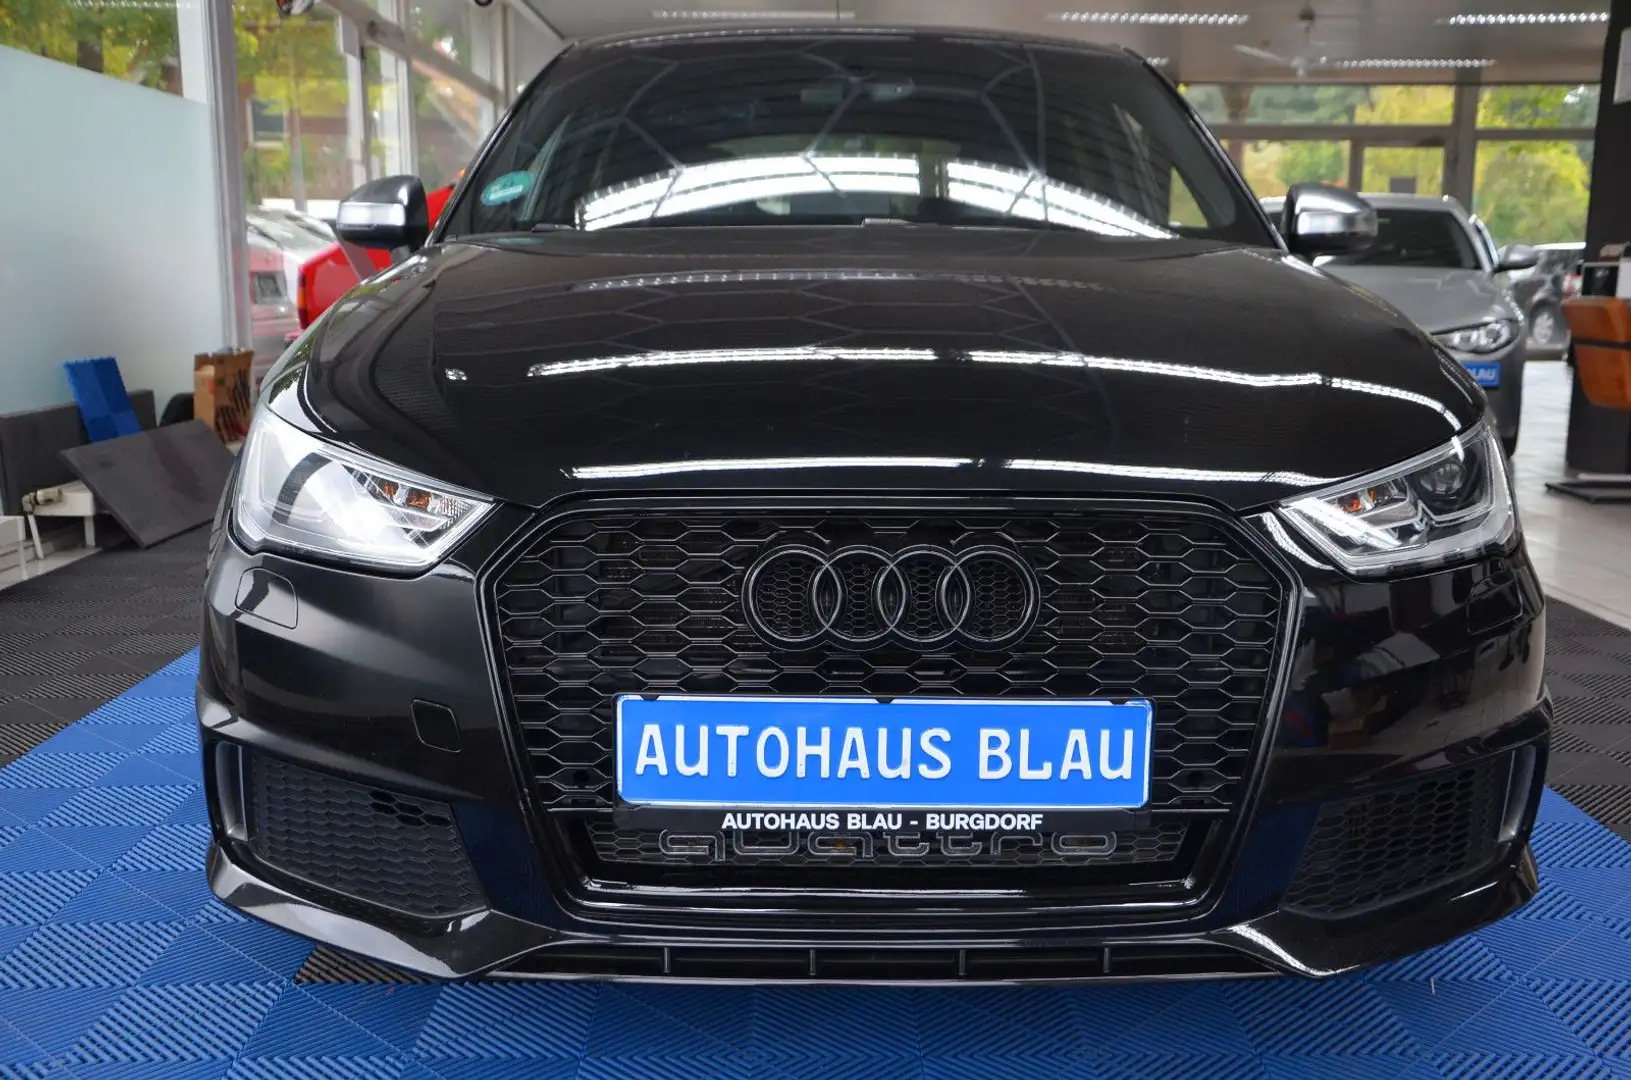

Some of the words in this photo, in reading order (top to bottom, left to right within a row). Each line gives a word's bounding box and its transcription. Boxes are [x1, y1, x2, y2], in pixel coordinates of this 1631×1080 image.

[635, 723, 952, 779] AUTOHAUS
[978, 727, 1134, 780] BLAU
[721, 812, 840, 830] AUTOHAUS
[847, 812, 903, 830] BLAU
[925, 812, 1044, 831] BURGDORF
[658, 829, 1118, 862] quattro
